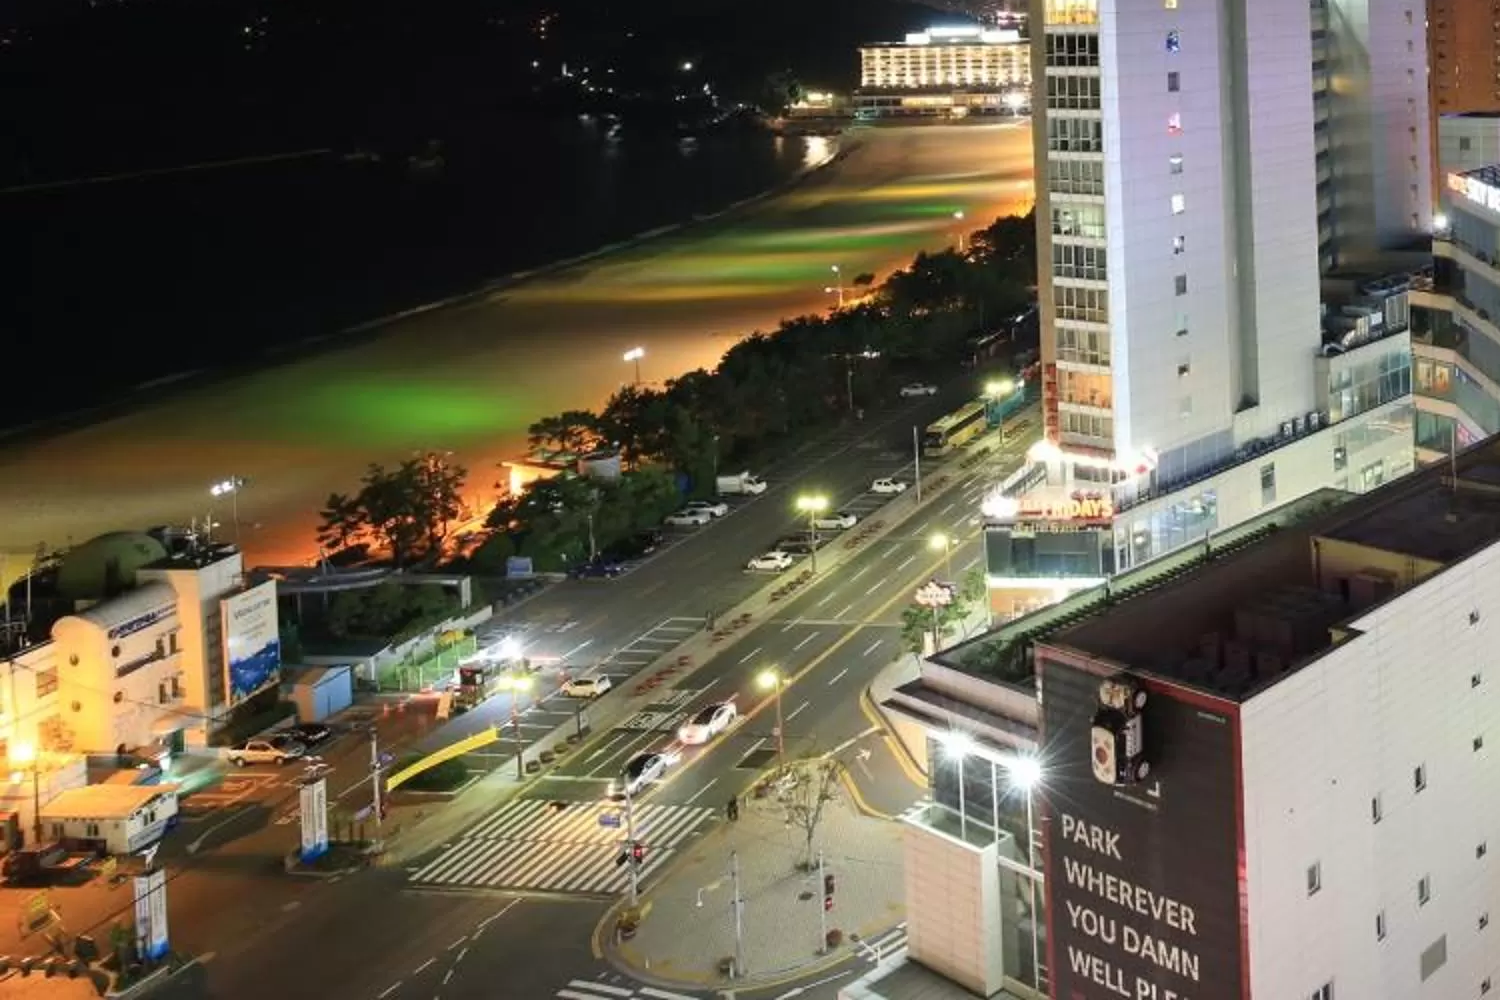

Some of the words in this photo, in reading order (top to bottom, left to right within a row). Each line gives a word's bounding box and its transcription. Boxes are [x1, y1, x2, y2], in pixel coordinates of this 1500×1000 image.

[1061, 813, 1122, 861] PARK
[1063, 855, 1198, 936] WHEREVER
[1066, 899, 1116, 944] YOU
[1122, 925, 1200, 982] DAMN
[1068, 945, 1132, 998] WELL
